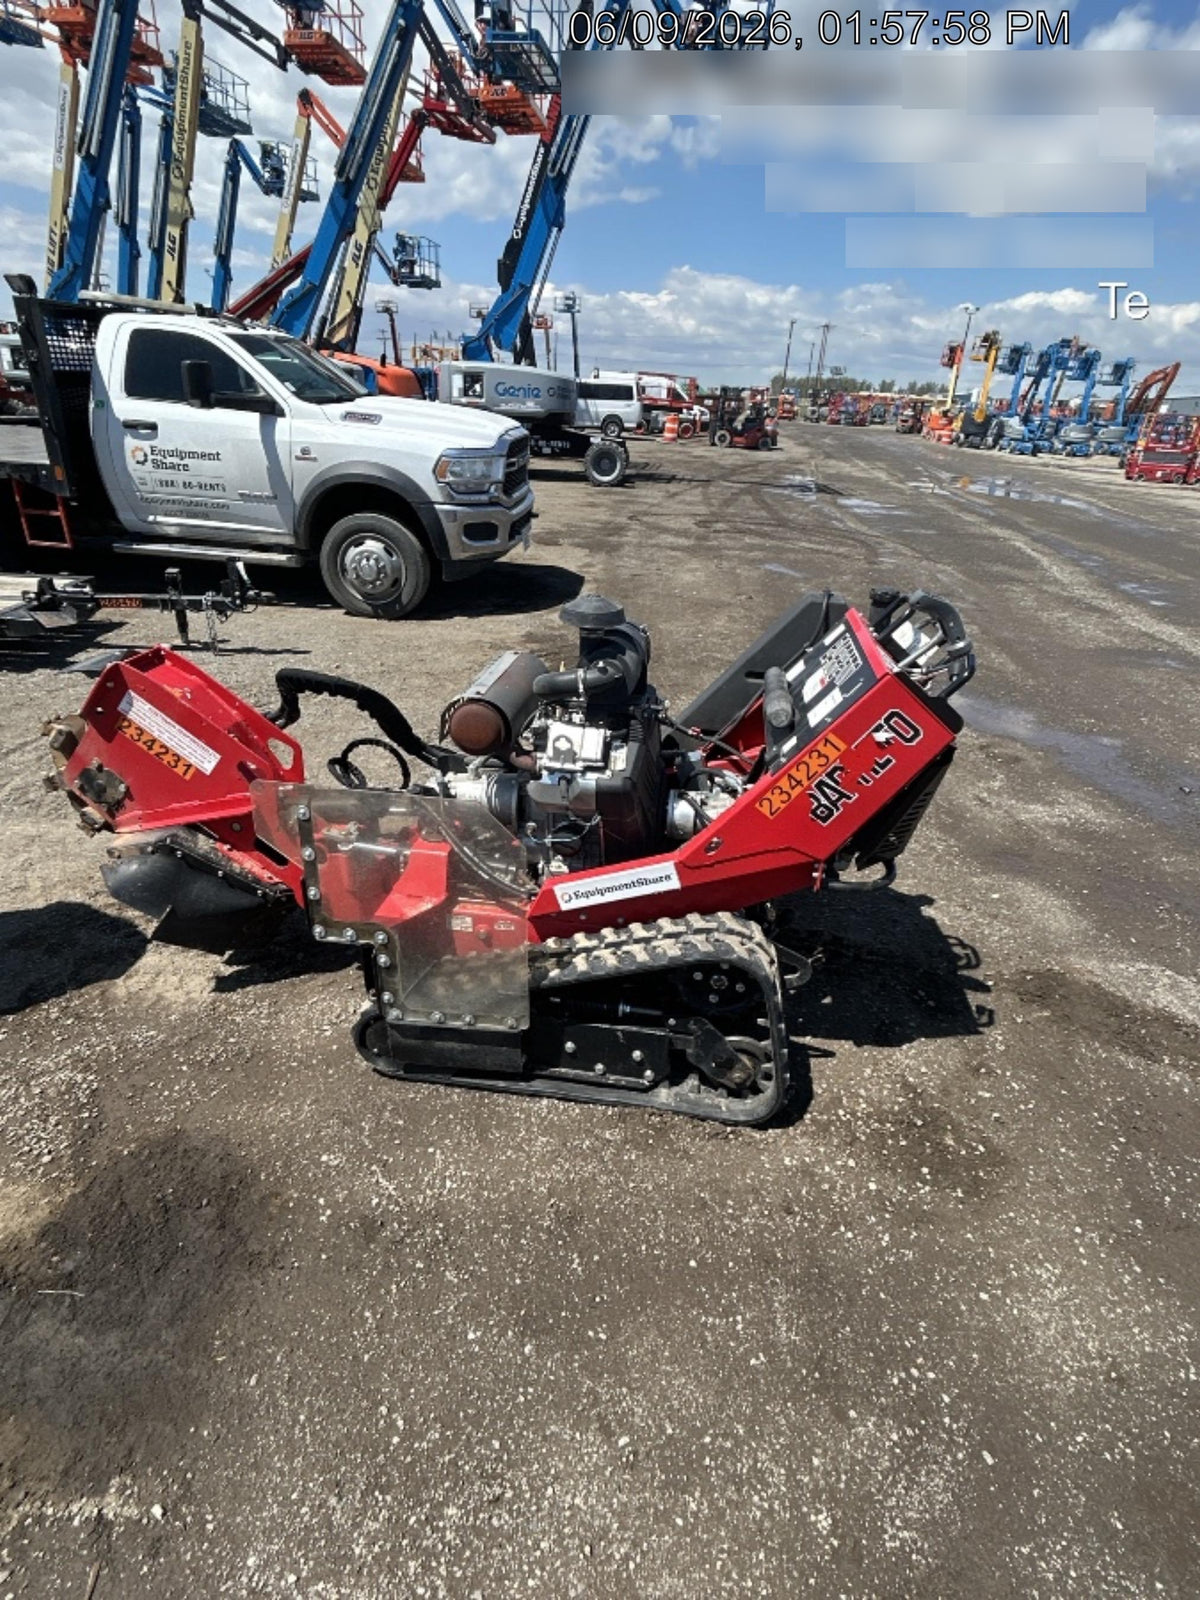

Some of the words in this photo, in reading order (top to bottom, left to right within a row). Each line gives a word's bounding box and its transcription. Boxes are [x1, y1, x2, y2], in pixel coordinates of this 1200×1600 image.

[173, 41, 192, 163] EquipmentShare
[166, 232, 176, 261] JLG
[351, 240, 363, 269] JLG
[495, 382, 541, 399] Genie
[150, 446, 222, 461] Equipment
[151, 458, 190, 472] Share
[118, 717, 193, 778] 234231
[758, 736, 842, 817] 234231
[573, 874, 673, 900] EquipmentShare
